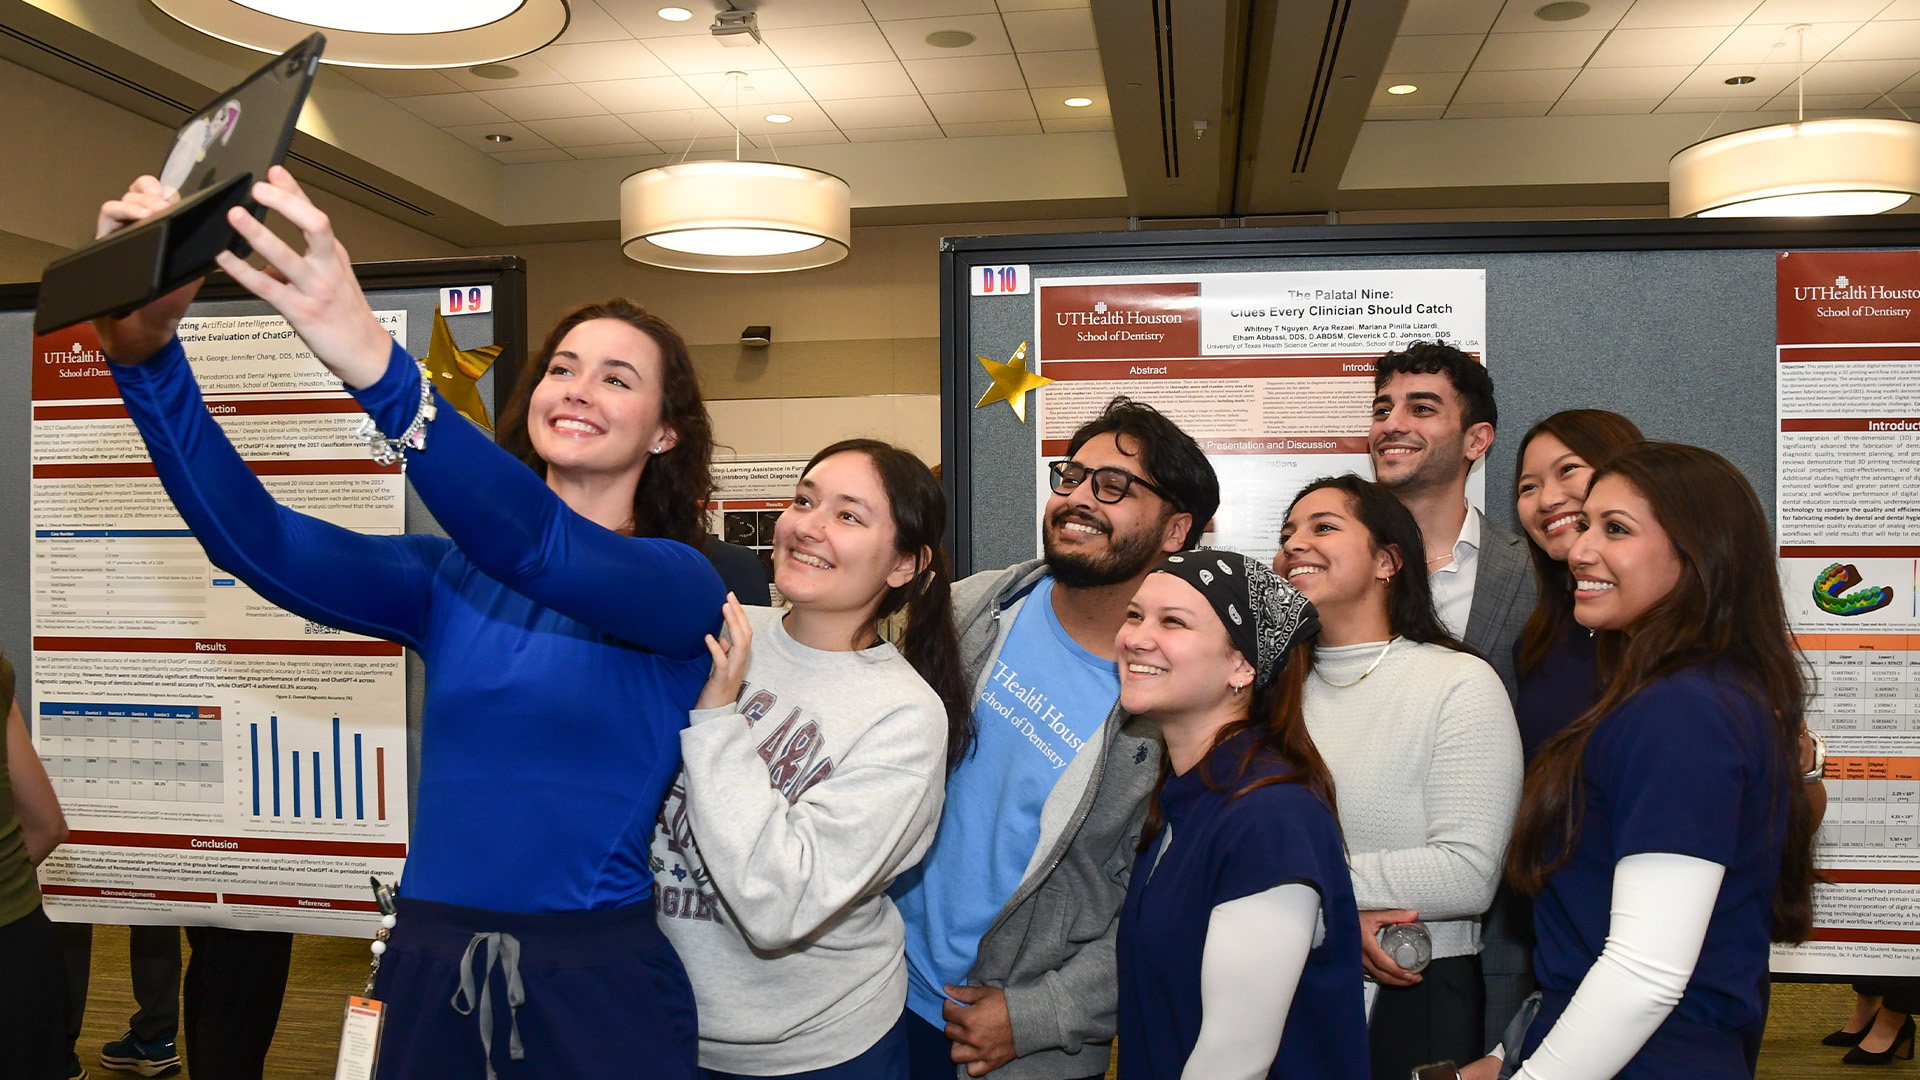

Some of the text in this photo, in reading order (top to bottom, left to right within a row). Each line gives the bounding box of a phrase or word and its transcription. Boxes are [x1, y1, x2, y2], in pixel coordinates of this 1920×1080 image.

[1288, 289, 1393, 300] The Palatal Nine:
[1794, 285, 1920, 300] UTHealth Housto
[1231, 304, 1453, 318] Clues Every Clinician Should Catch
[1817, 306, 1911, 318] School of Dentistry
[1056, 311, 1182, 326] UTHealth Houston
[177, 319, 284, 331] rating Artificial Intelligence
[178, 334, 206, 343] arative
[208, 332, 250, 341] Evaluation
[252, 332, 261, 340] of
[1077, 331, 1165, 343] School of Dentistry
[1129, 366, 1167, 375] Abstract
[1343, 363, 1378, 372] Introdu
[59, 369, 82, 378] School
[84, 368, 91, 377] of
[294, 371, 323, 379] University
[1868, 420, 1920, 430] Introduct
[1207, 440, 1337, 450] Presentation and Discussion
[195, 642, 227, 651] Results
[993, 661, 1048, 715] Health
[981, 688, 1067, 770] chool of Dentistry
[191, 839, 239, 849] Conclusion
[101, 889, 156, 898] Acknowledgements
[298, 899, 331, 907] References
